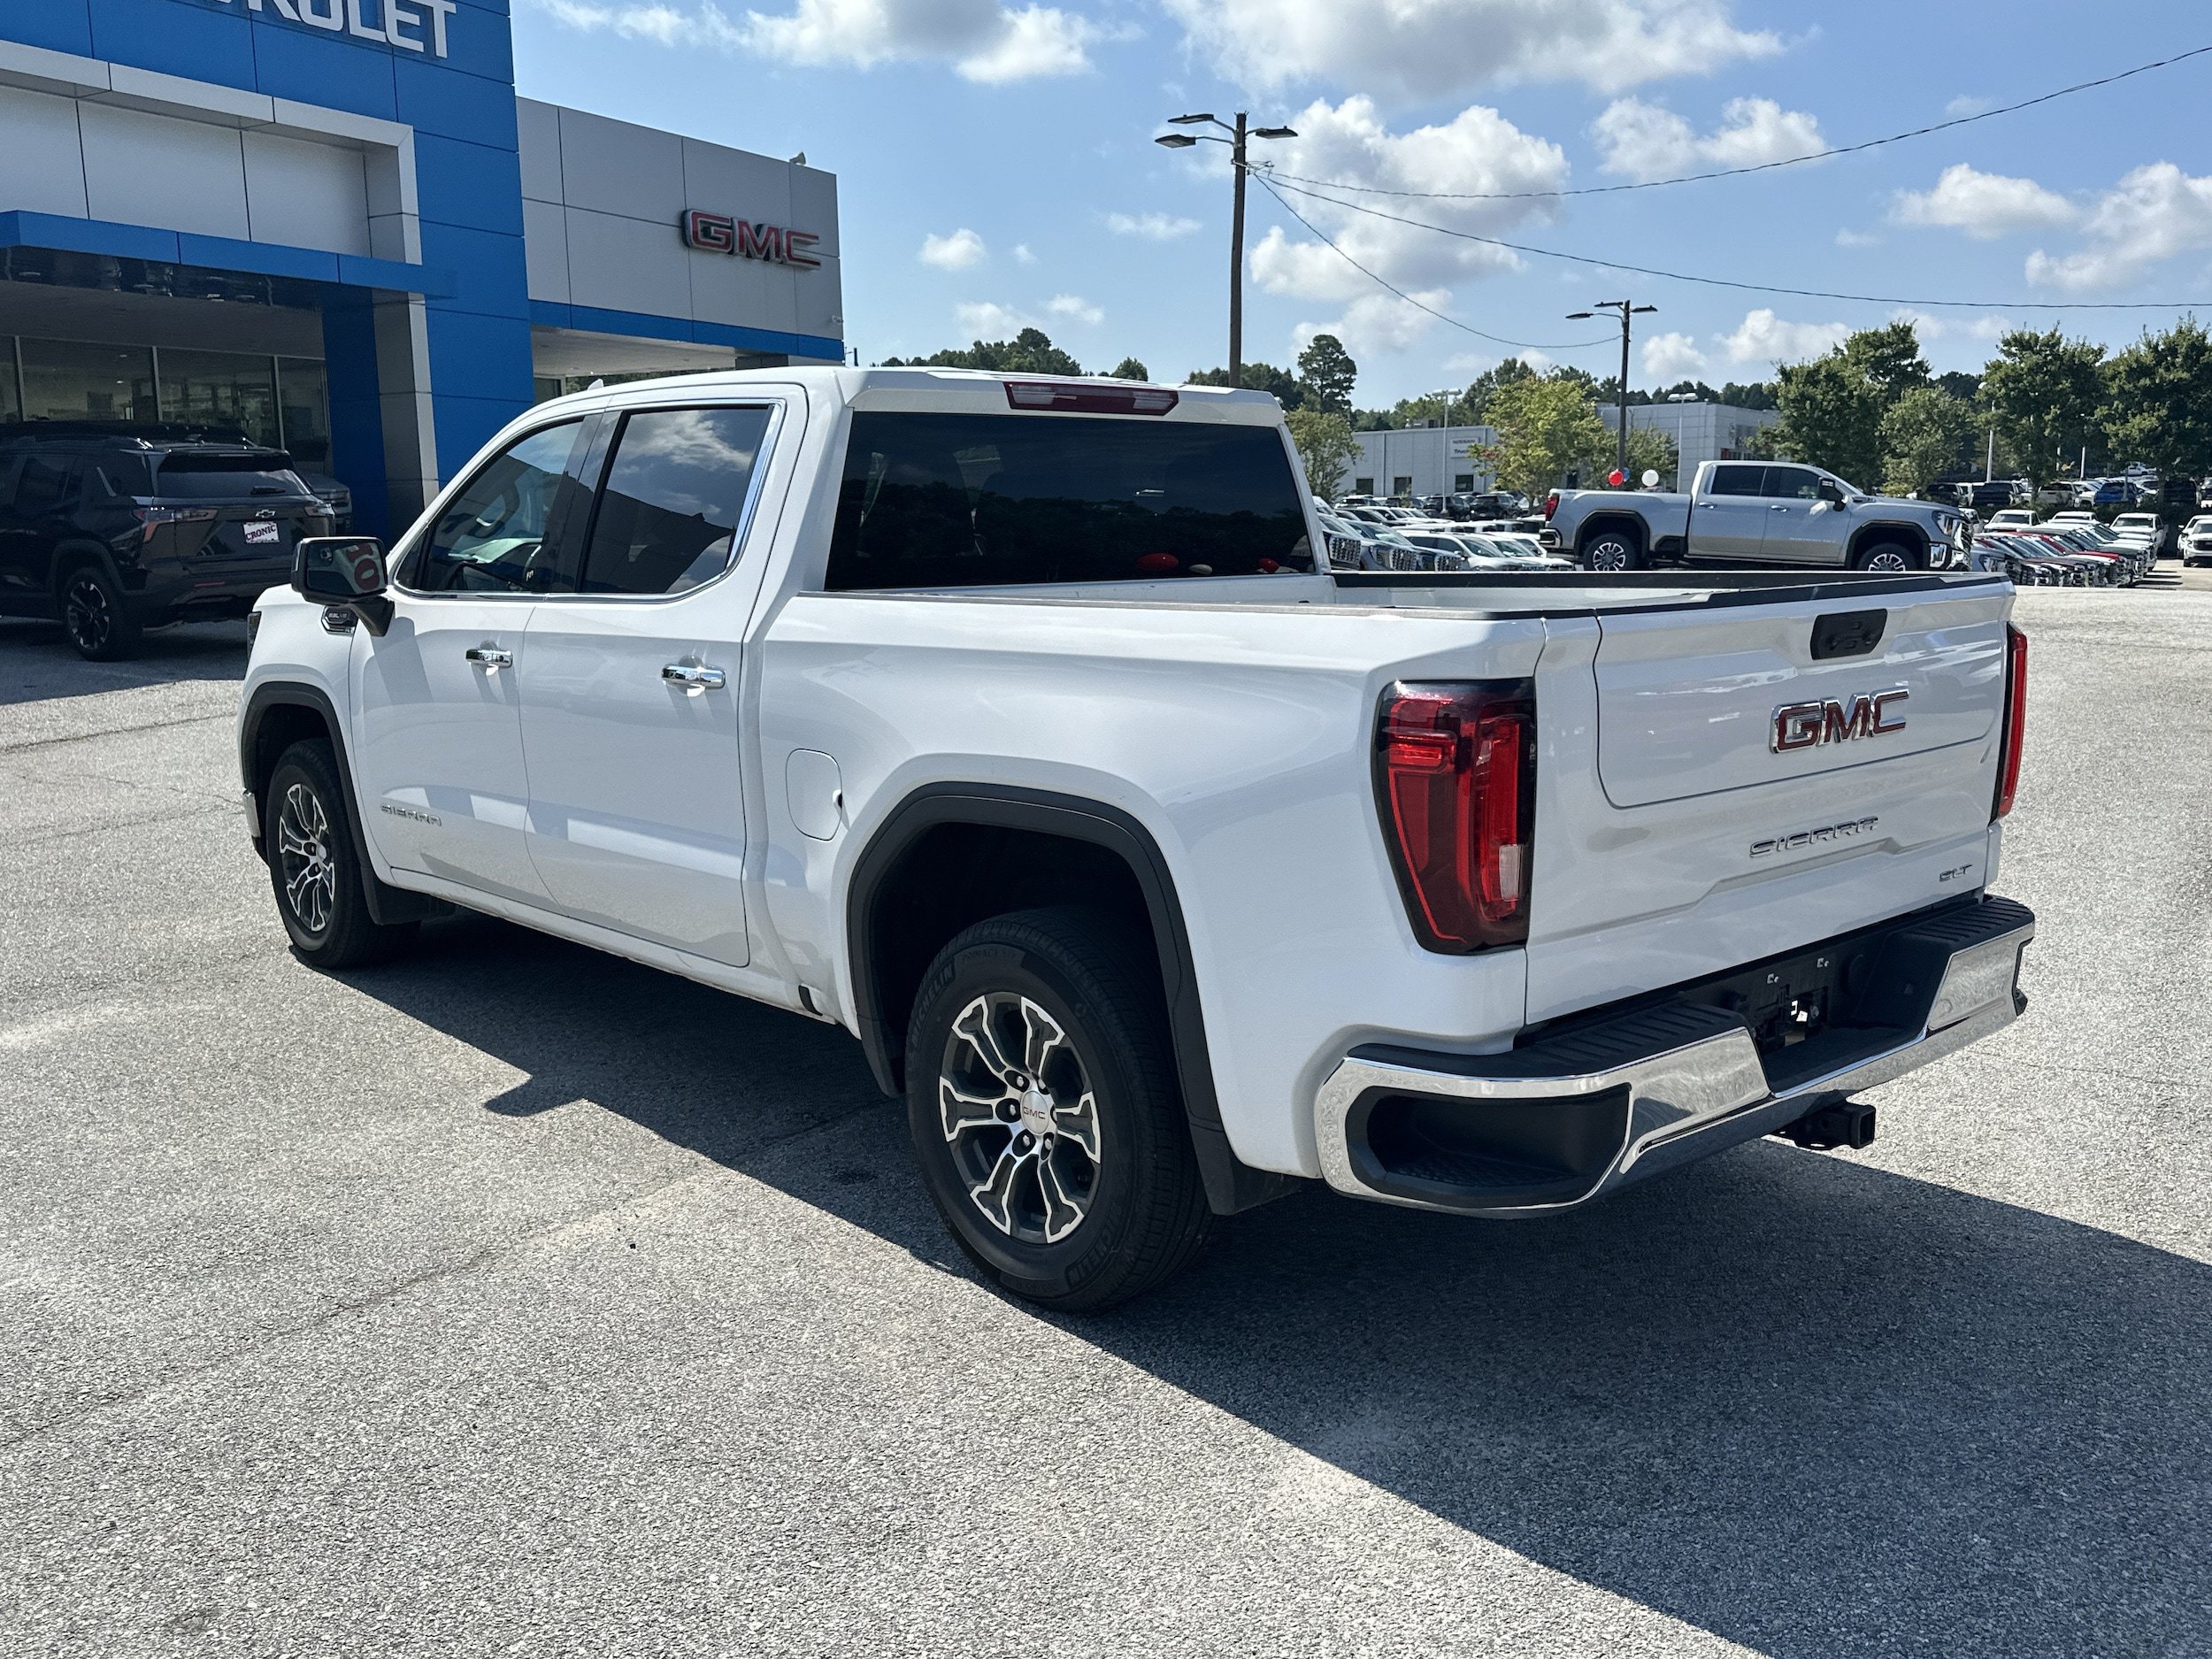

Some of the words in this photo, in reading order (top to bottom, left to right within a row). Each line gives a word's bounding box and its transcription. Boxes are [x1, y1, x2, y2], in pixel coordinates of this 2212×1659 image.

[681, 208, 821, 269] GMC
[245, 524, 276, 540] CRONIC
[1770, 687, 1909, 753] GMC
[380, 803, 442, 826] SIERRA
[1749, 816, 1879, 858] SIERRA
[1023, 1106, 1046, 1119] GMC
